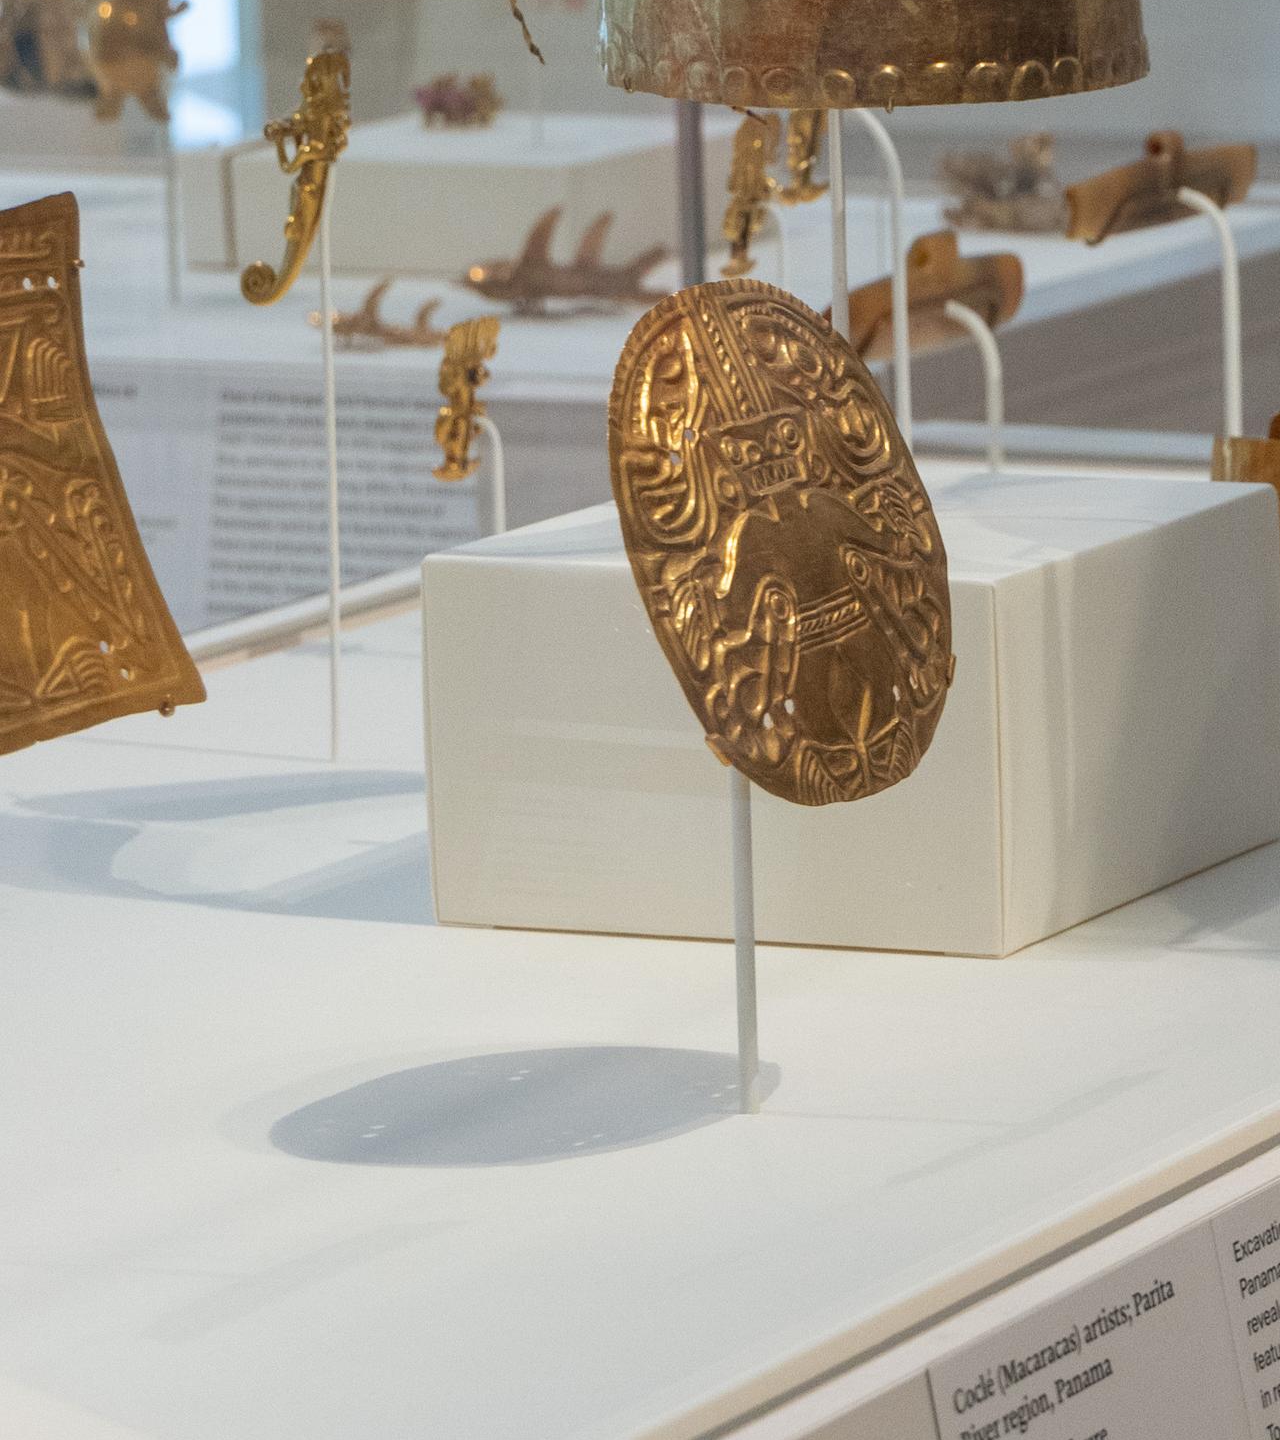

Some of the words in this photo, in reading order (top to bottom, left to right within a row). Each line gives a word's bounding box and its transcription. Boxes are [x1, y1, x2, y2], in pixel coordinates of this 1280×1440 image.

[953, 1374, 995, 1414] Coclé
[997, 1324, 1081, 1395] (Macaracas)
[1083, 1303, 1133, 1344] artists;
[1131, 1280, 1175, 1317] Parita
[1001, 1392, 1055, 1434] region,
[1053, 1357, 1113, 1404] Panama
[1259, 1389, 1272, 1408] in
